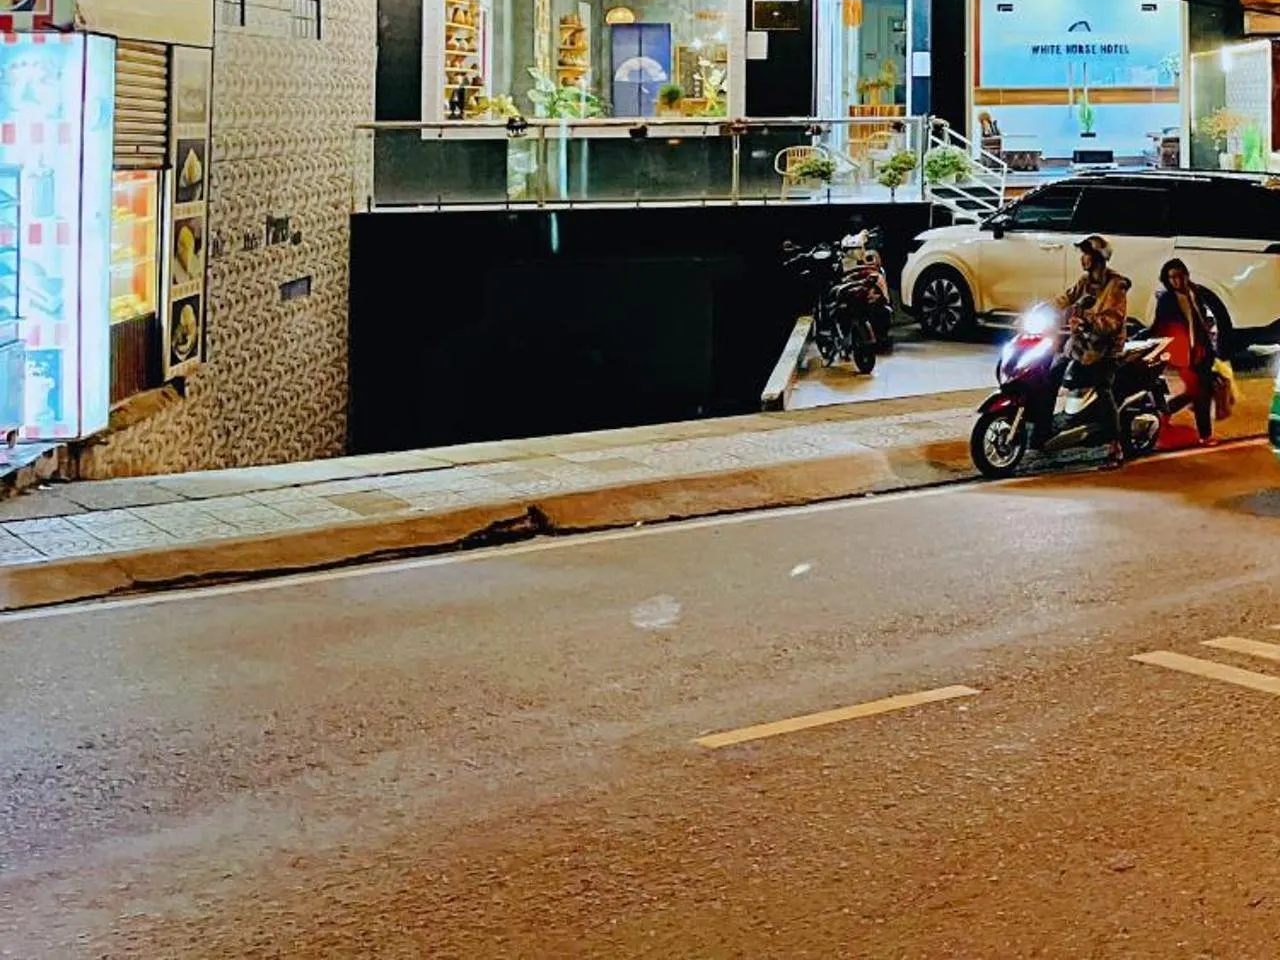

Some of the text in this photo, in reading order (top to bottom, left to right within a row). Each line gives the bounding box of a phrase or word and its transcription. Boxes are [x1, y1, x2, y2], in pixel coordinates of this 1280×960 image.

[1031, 43, 1130, 55] WHITE HORSE HOTEL
